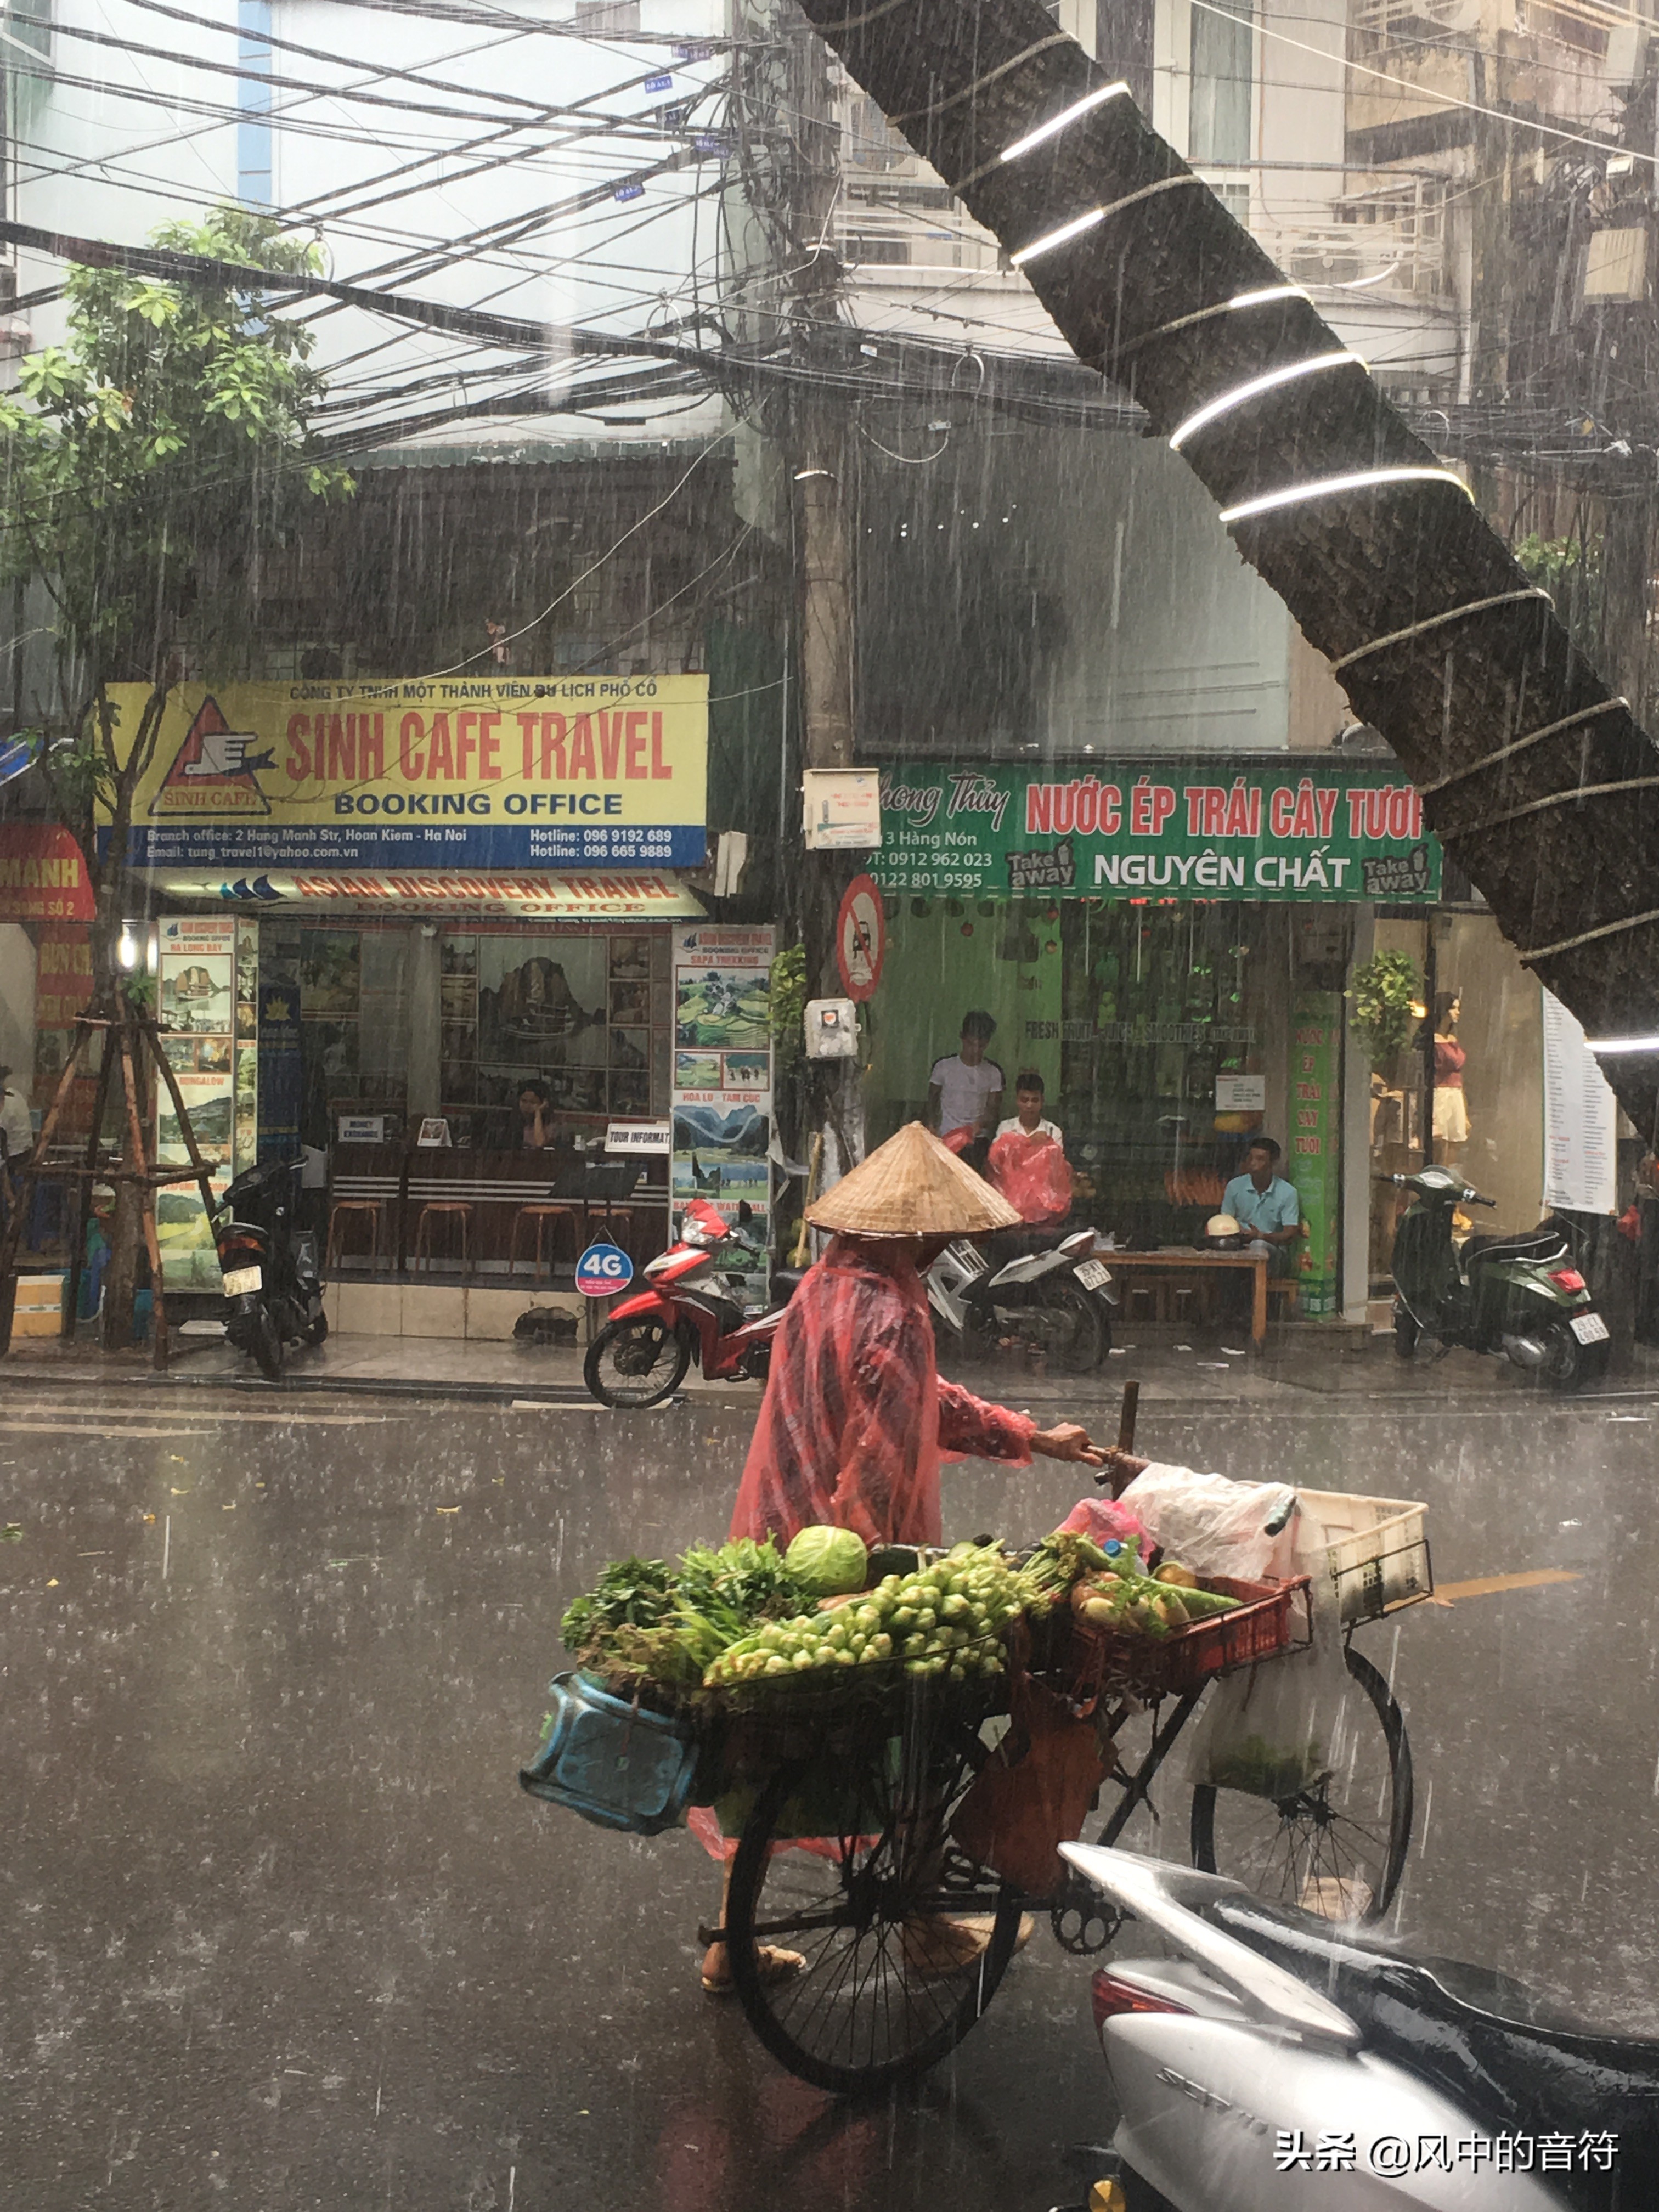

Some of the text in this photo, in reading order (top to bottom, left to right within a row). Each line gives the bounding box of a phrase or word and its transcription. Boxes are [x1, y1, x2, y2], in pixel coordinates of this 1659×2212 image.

[337, 685, 354, 699] TY
[359, 685, 398, 698] TNHH
[439, 681, 491, 698] THÀNH
[496, 681, 530, 697] VIÊN
[286, 711, 673, 781] SINH CAFE TRAVEL
[164, 791, 205, 806] SINH
[335, 794, 622, 815] BOOKING OFFICE
[1025, 774, 1122, 836] NƯỚC
[1130, 775, 1176, 836] ÉP
[1183, 776, 1262, 837] TRÁI
[1269, 777, 1339, 838] CÂY
[146, 830, 190, 842] Branch
[193, 830, 232, 842] office:
[235, 830, 244, 842] 2
[247, 830, 279, 844] Hang
[283, 830, 317, 842] Manh
[320, 830, 342, 843] Str,
[345, 830, 377, 842] Hoan
[382, 830, 413, 842] Kiem
[425, 830, 442, 842] Ha
[445, 830, 467, 842] Noi
[530, 830, 672, 842] Hotline: 096 9192 689
[885, 832, 895, 845] 3
[900, 831, 940, 848] Hàng
[945, 831, 977, 846] Nón
[146, 846, 184, 858] Email:
[530, 845, 580, 857] Hotline:
[583, 845, 608, 857] 096
[612, 845, 636, 857] 665
[889, 853, 927, 866] 0912
[931, 853, 960, 866] 962
[963, 854, 992, 866] 023
[1008, 852, 1054, 871] Take
[1094, 845, 1351, 887] NGUYÊN CHẤT
[1364, 859, 1409, 877] Take
[911, 873, 938, 887] 801
[944, 873, 982, 887] 9595
[1012, 865, 1074, 887] away
[1367, 871, 1427, 892] away
[291, 876, 679, 899] ASIAN DISCOVERY TRAVEL
[520, 903, 645, 912] OFFICE
[1025, 1021, 1059, 1039] FRESH
[610, 1131, 670, 1143] TOUR INFORMAT
[583, 1254, 622, 1276] 4G
